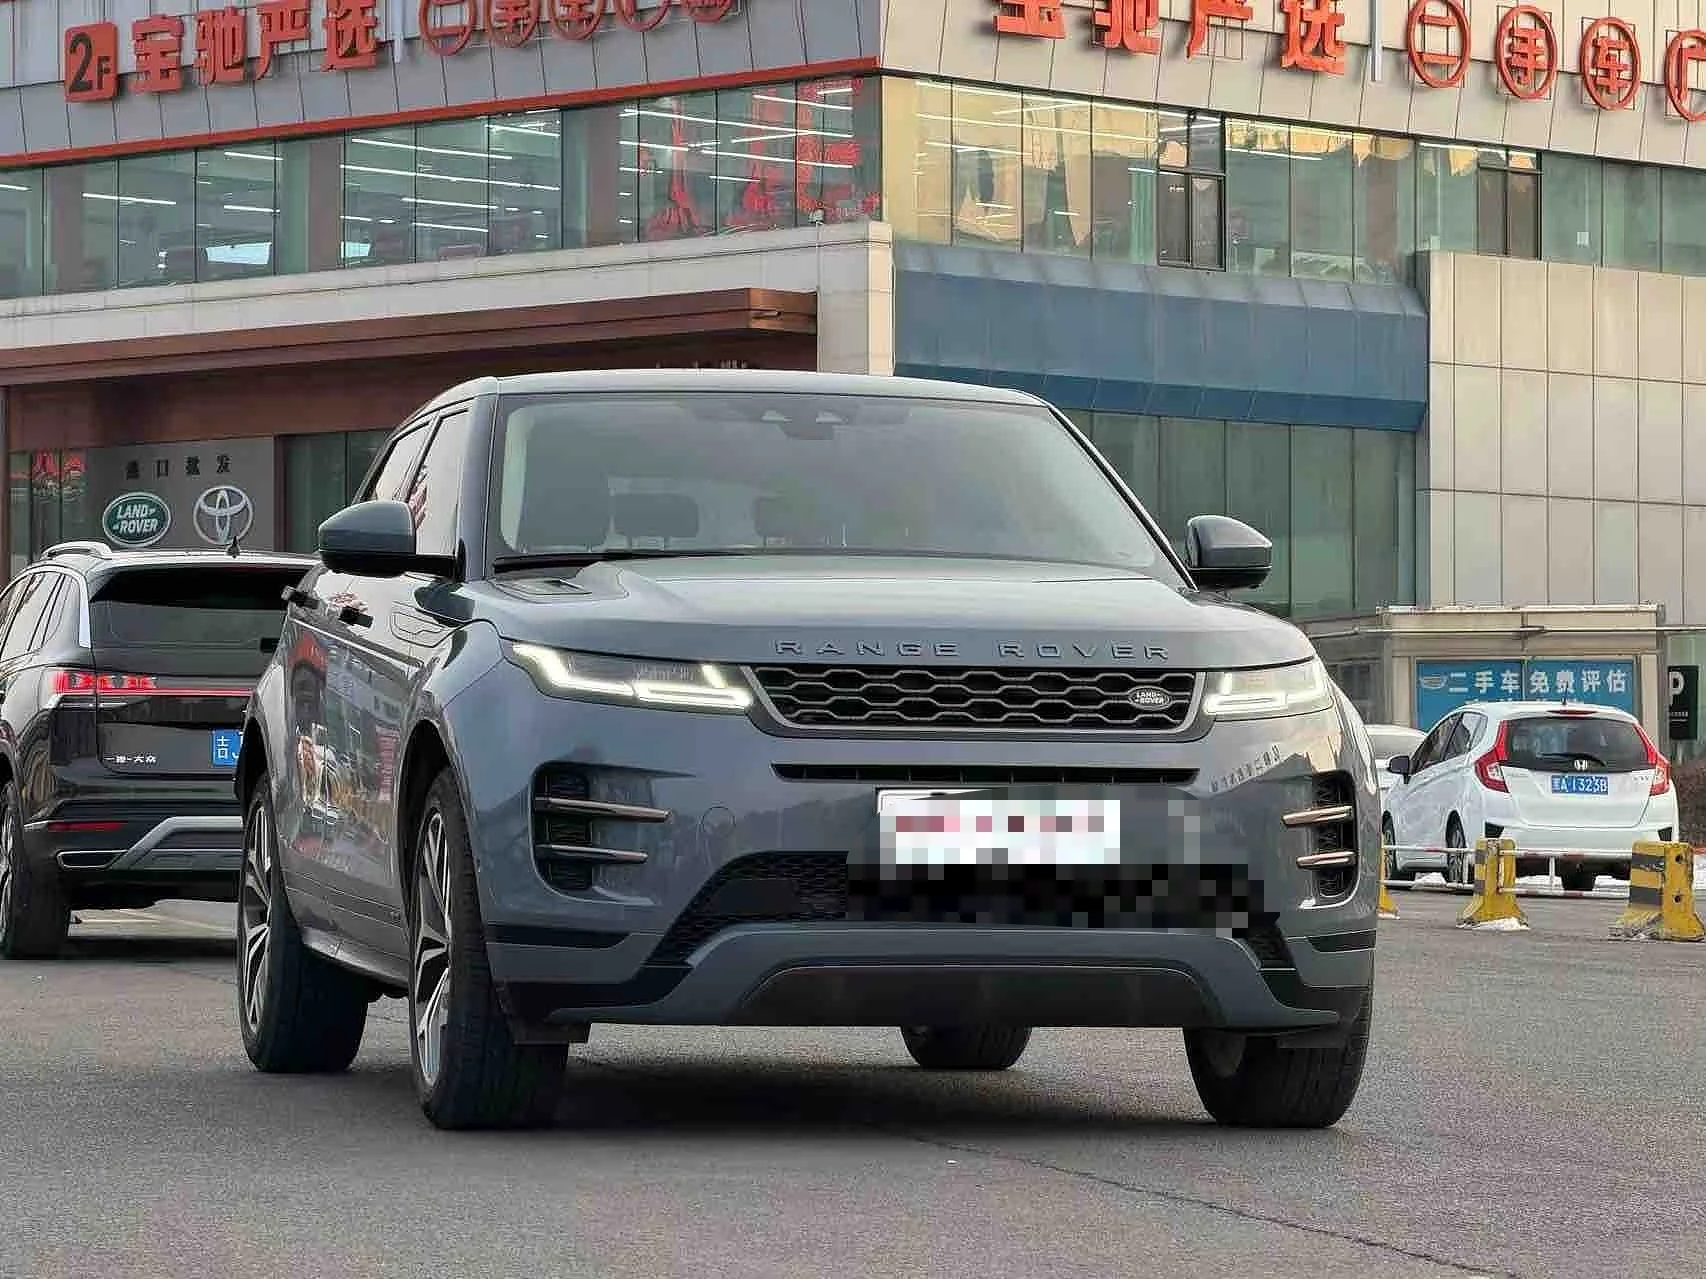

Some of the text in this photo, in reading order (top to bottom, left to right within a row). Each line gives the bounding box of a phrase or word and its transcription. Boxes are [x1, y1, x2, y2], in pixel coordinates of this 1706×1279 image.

[68, 0, 733, 93] 2F 宝驰严选 二手车
[117, 503, 149, 519] LAND
[119, 518, 159, 534] ROVER
[775, 640, 1170, 661] RANGE ROVER
[1668, 672, 1684, 705] P
